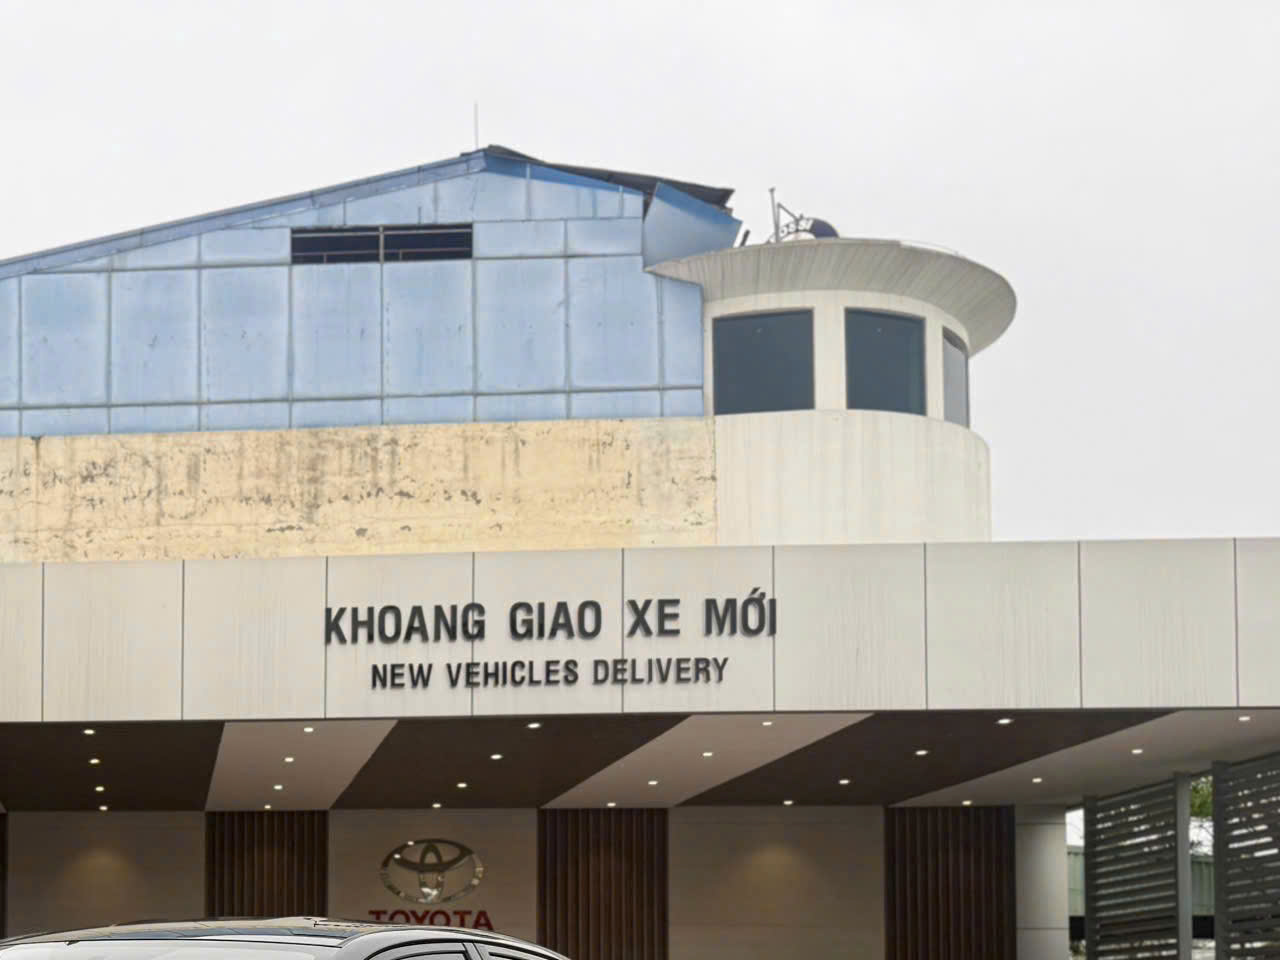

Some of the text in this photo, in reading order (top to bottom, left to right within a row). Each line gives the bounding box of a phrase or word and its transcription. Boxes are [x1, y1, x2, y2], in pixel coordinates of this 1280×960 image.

[325, 587, 777, 645] KHOANG GIAO XE MỚI
[371, 657, 728, 690] NEW VEHICLES DELIVERY
